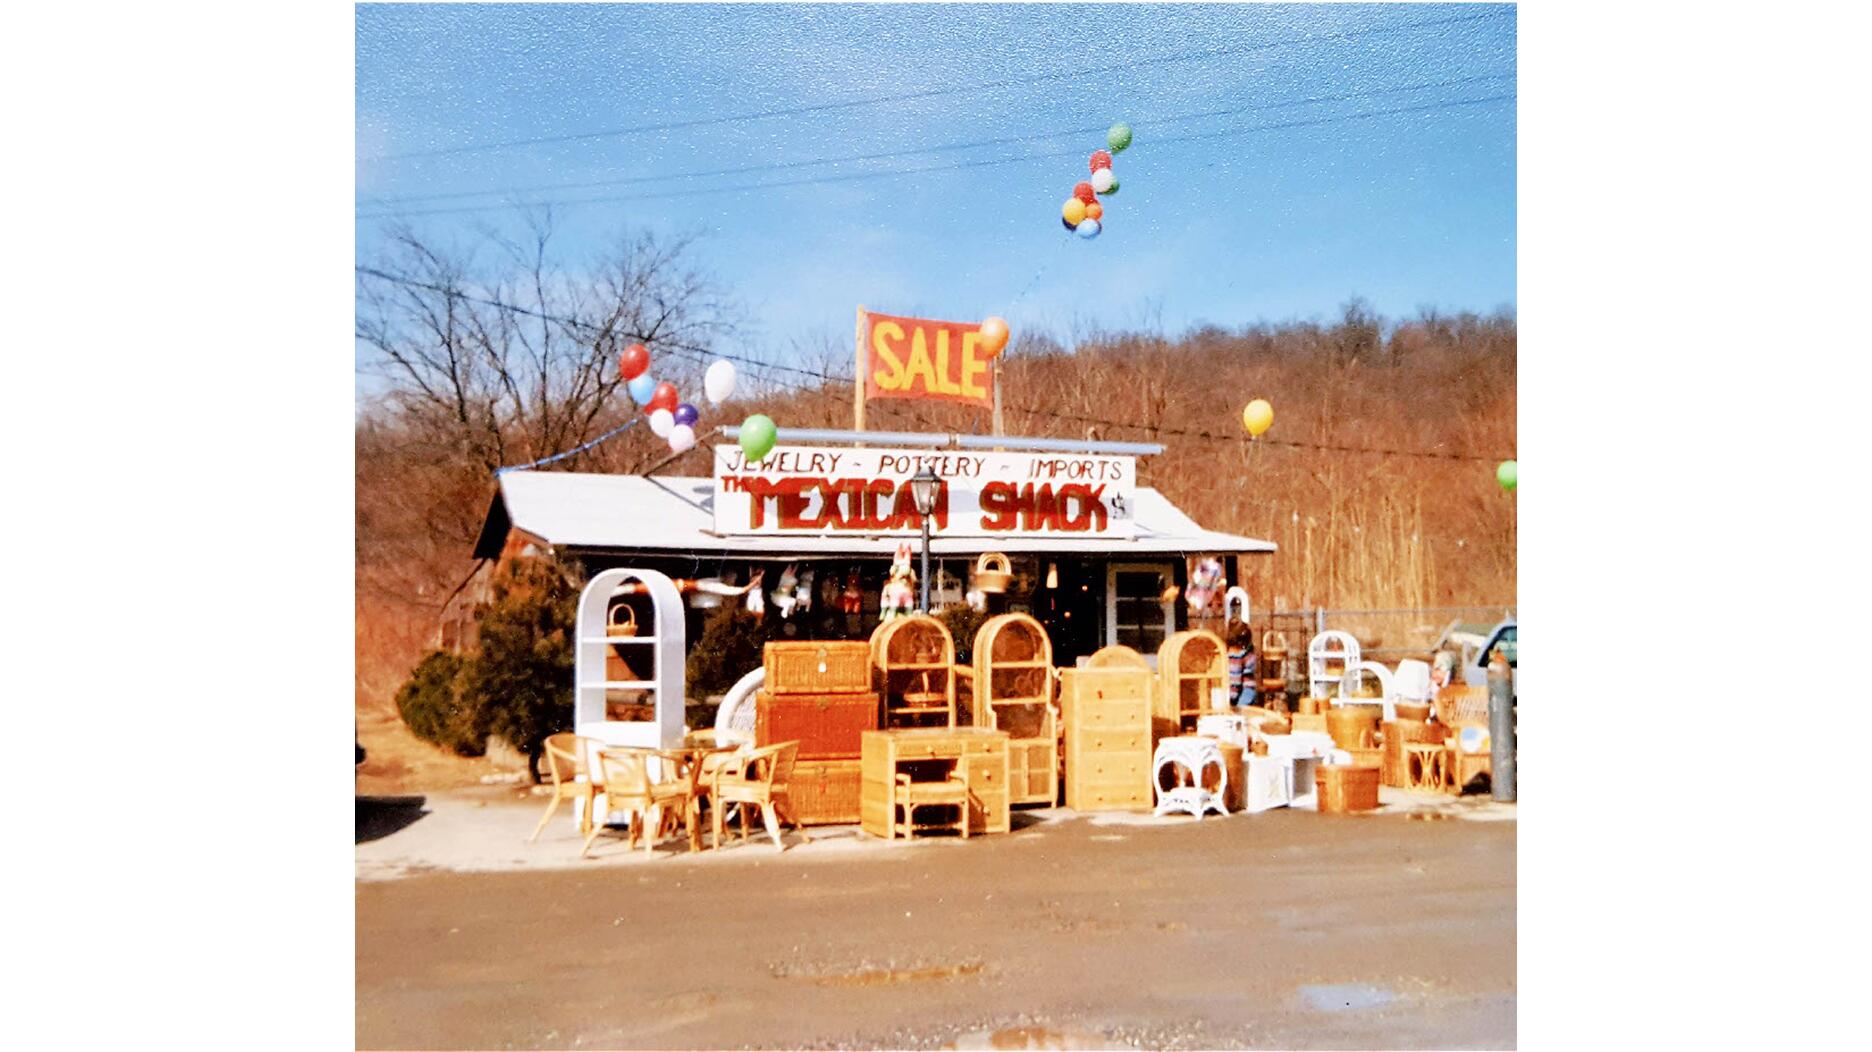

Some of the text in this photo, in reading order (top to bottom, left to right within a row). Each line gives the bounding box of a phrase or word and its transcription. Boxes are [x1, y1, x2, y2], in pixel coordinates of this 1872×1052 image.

[873, 321, 987, 400] SALE
[877, 454, 986, 479] POTTERY
[1028, 458, 1122, 481] IMPORTS
[748, 476, 949, 532] MEXICAN
[978, 480, 1109, 533] SHACK
